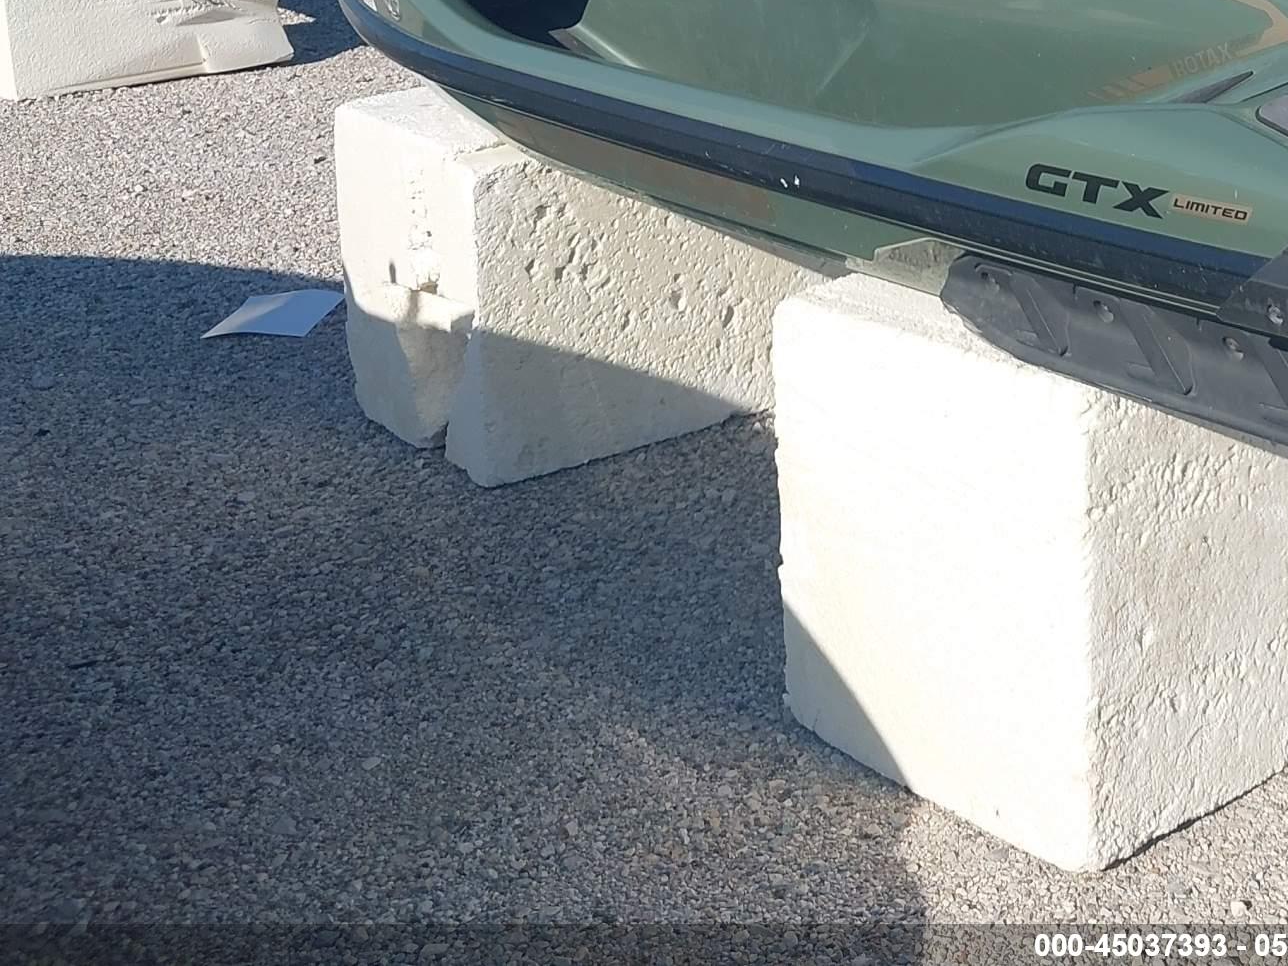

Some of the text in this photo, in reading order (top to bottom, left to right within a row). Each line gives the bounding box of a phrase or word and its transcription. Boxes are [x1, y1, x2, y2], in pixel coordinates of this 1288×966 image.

[1171, 41, 1233, 79] ROTAX
[1025, 163, 1248, 221] GTX LIMITED
